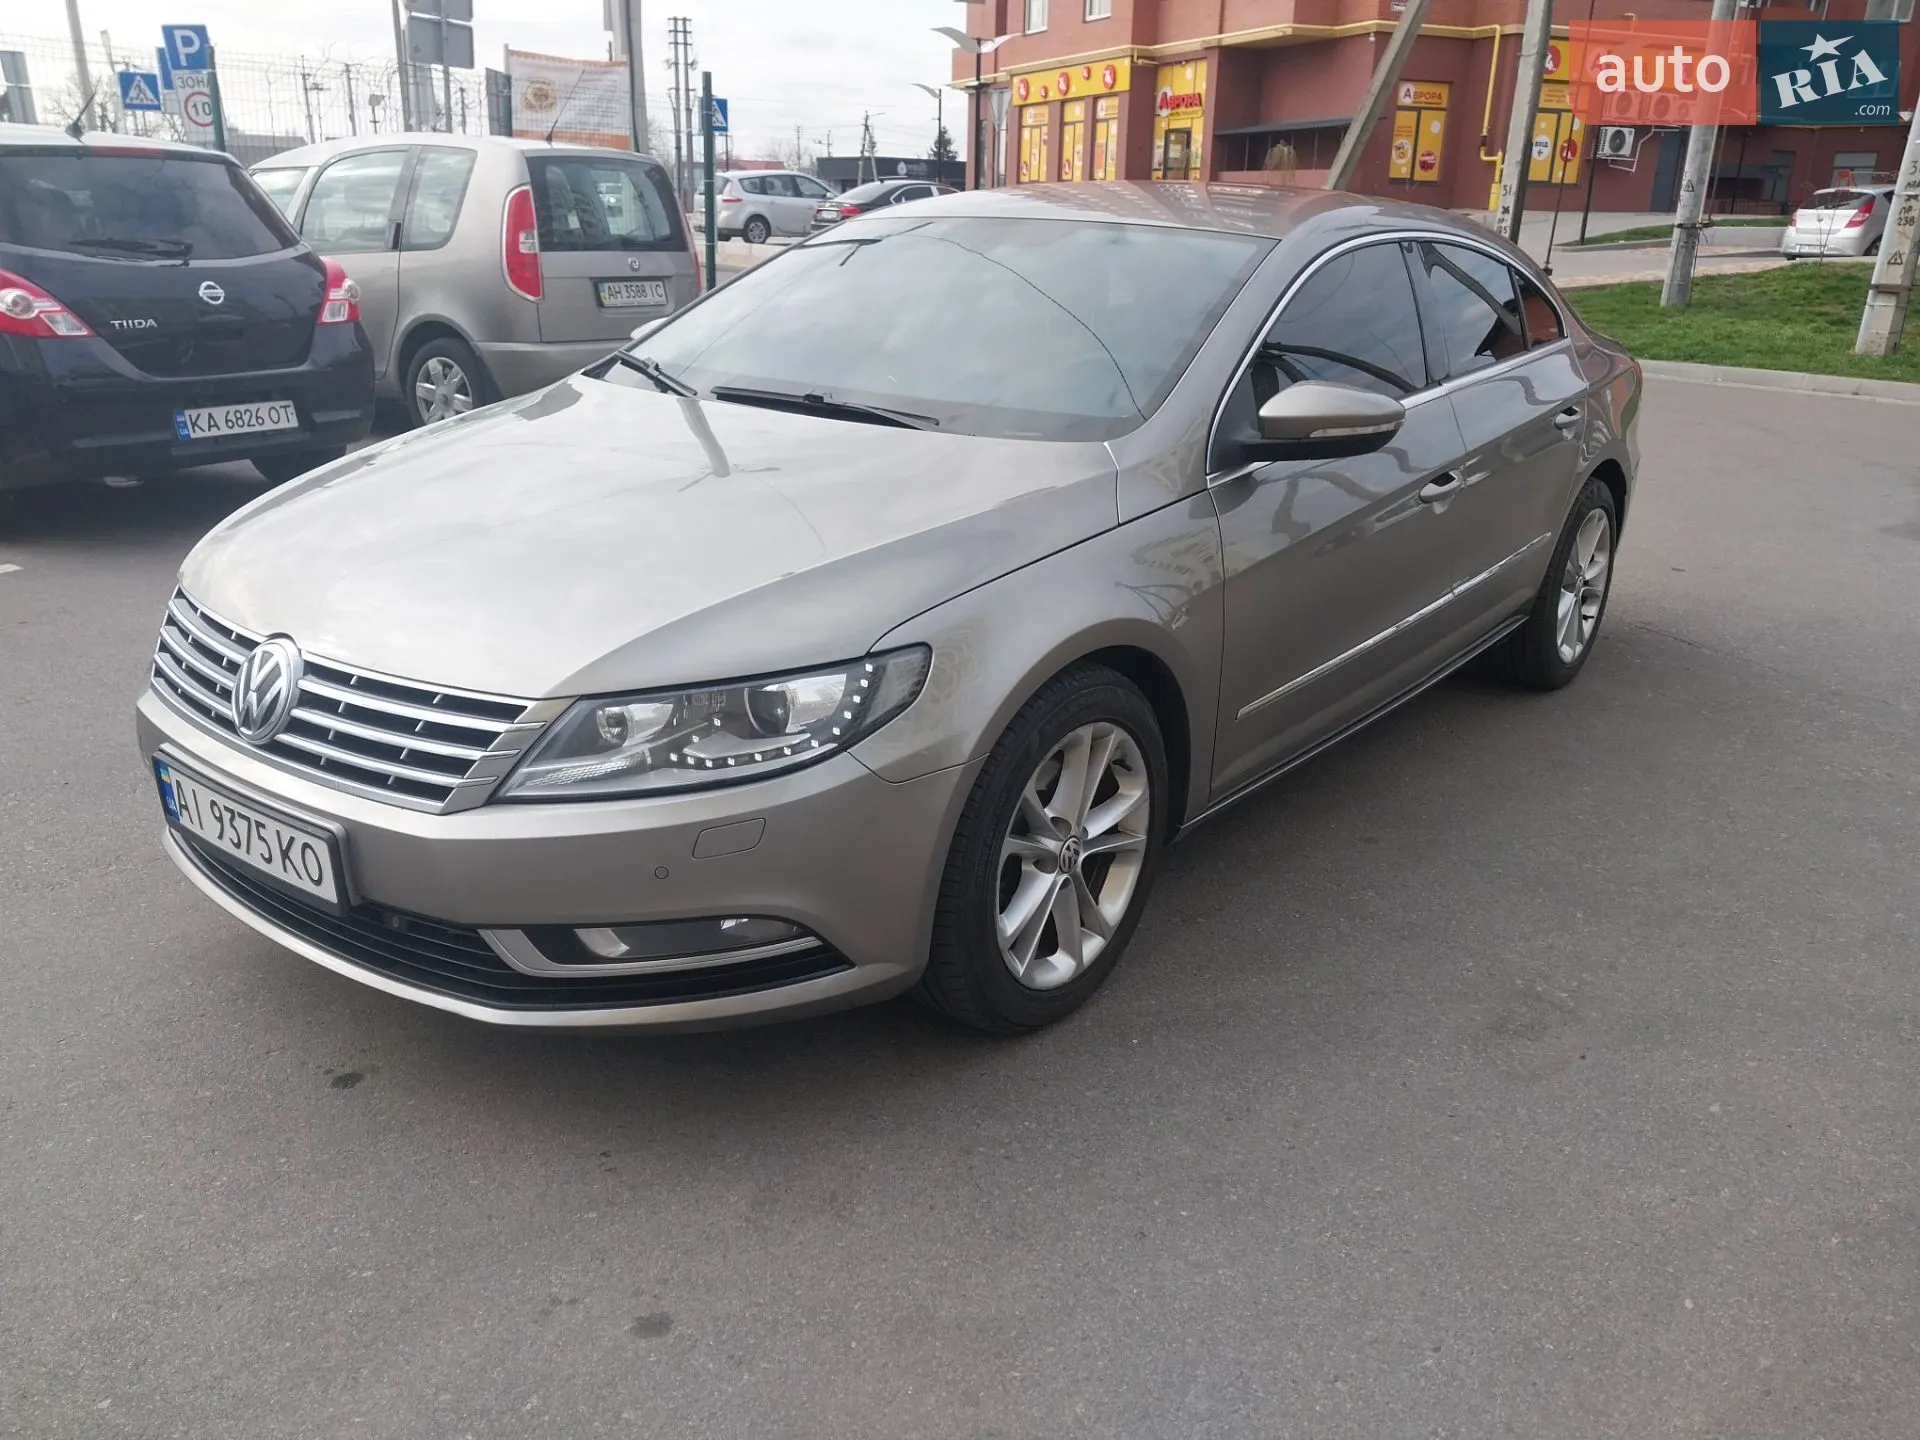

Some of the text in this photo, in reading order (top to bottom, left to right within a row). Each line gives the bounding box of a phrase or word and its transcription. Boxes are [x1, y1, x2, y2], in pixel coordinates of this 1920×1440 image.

[173, 29, 200, 67] P
[191, 101, 212, 117] 10
[110, 318, 158, 330] TIIDA
[188, 405, 292, 433] KA 6826 OT
[174, 779, 204, 831] AI
